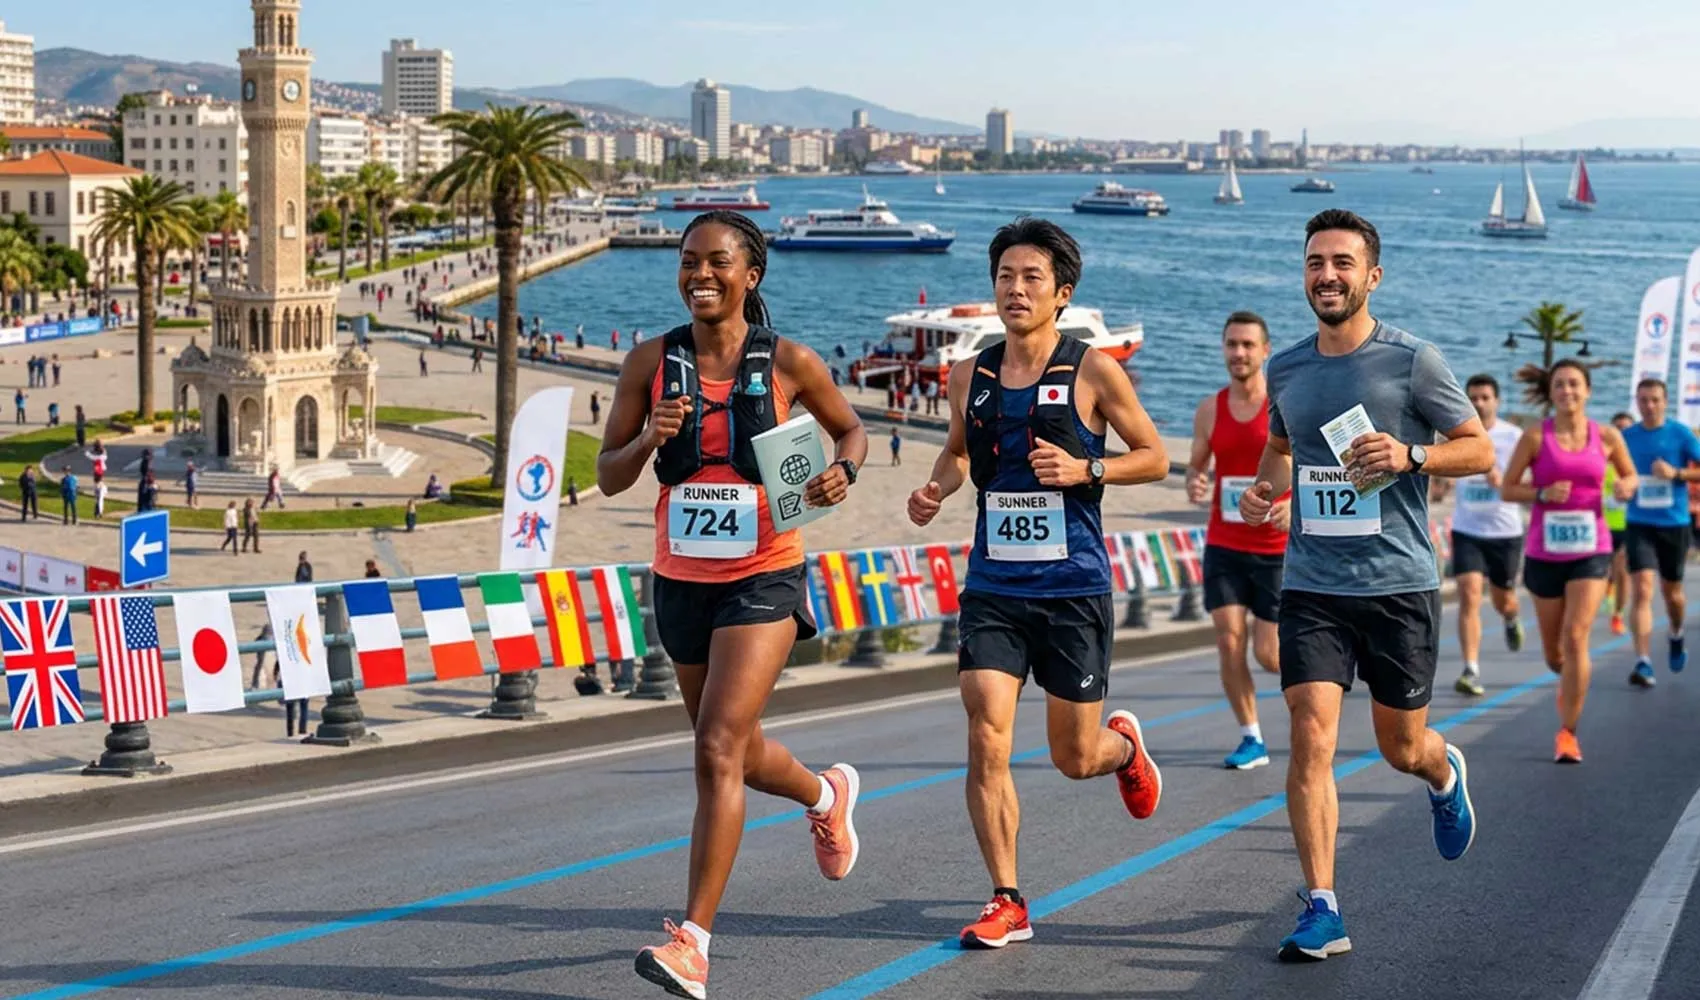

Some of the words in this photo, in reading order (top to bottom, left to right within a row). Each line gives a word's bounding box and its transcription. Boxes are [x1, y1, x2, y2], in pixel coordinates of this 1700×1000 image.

[1309, 471, 1352, 482] RUNNE
[683, 487, 740, 501] RUNNER
[1314, 489, 1357, 516] 112
[682, 507, 740, 536] 724
[997, 515, 1050, 542] 485
